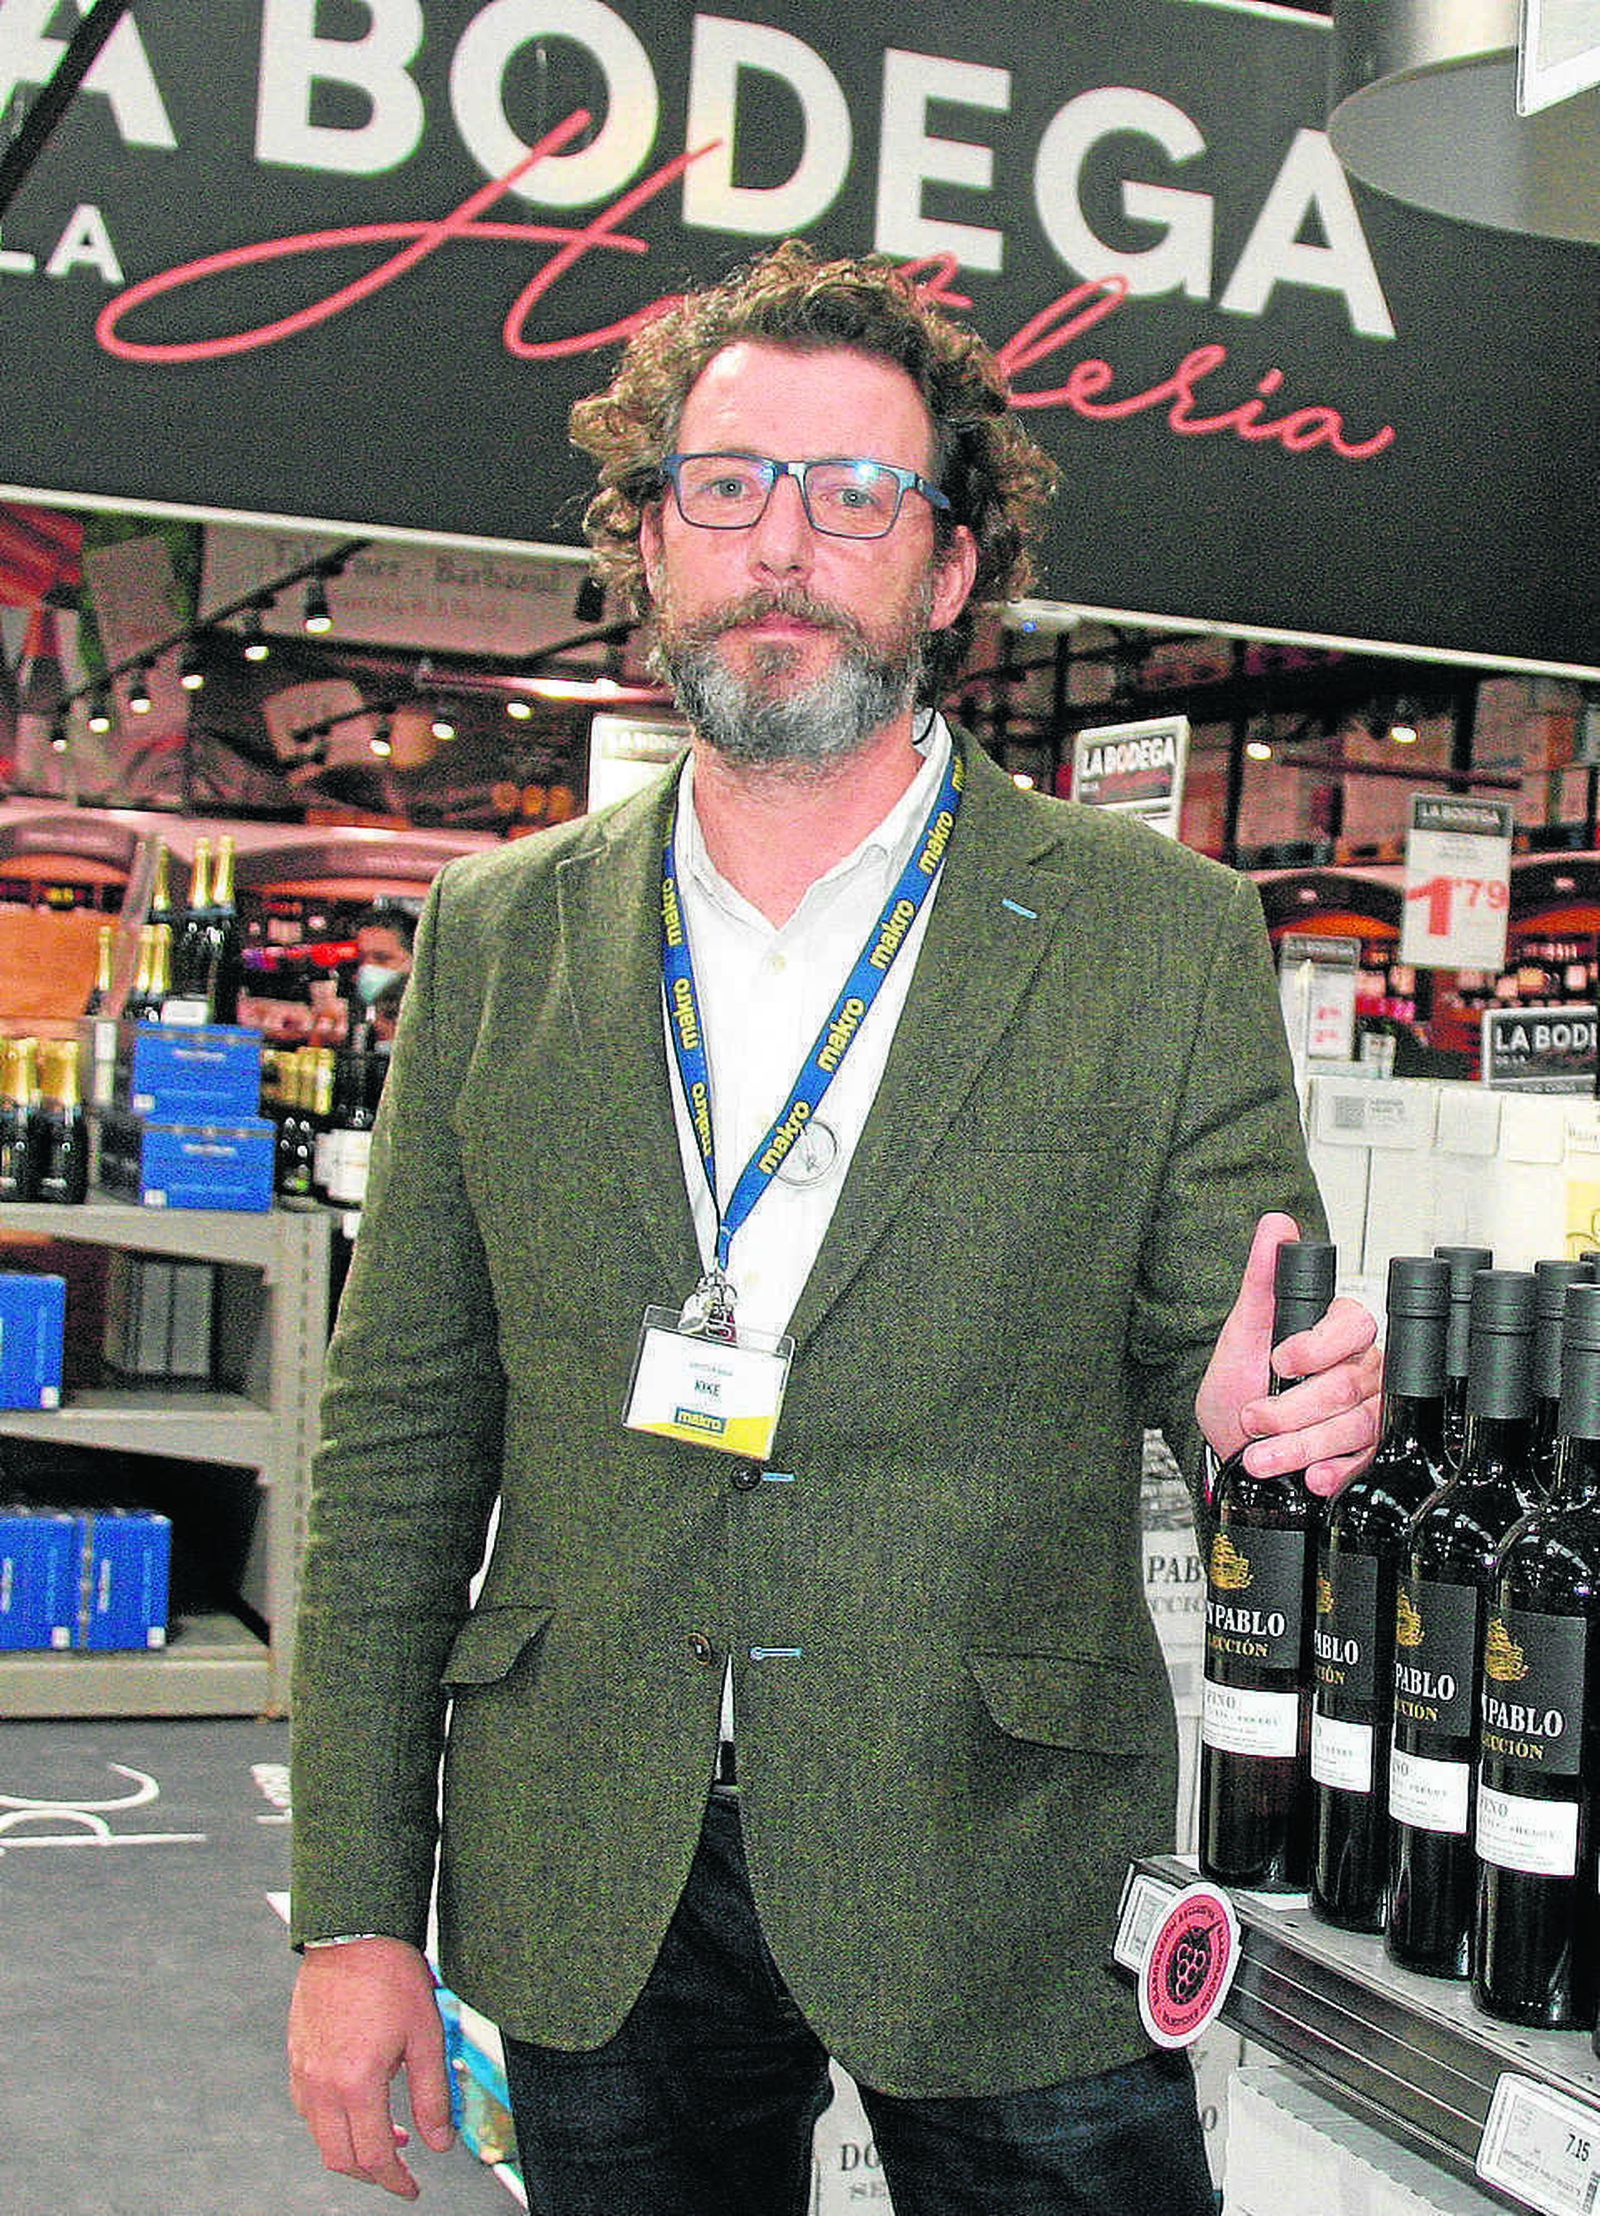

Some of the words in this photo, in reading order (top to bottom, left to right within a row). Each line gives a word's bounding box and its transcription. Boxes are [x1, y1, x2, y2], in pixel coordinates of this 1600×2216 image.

[255, 0, 1397, 342] BODEGA
[1081, 747, 1105, 778] LA
[1105, 735, 1176, 775] BODEGA
[918, 810, 954, 875] makro
[661, 878, 682, 947] makro
[869, 899, 915, 970] makro
[671, 976, 699, 1051] makro
[815, 997, 865, 1073] makro
[1495, 1024, 1530, 1053] LA
[757, 1100, 810, 1176] makro
[1566, 2133, 1591, 2162] 7.15
